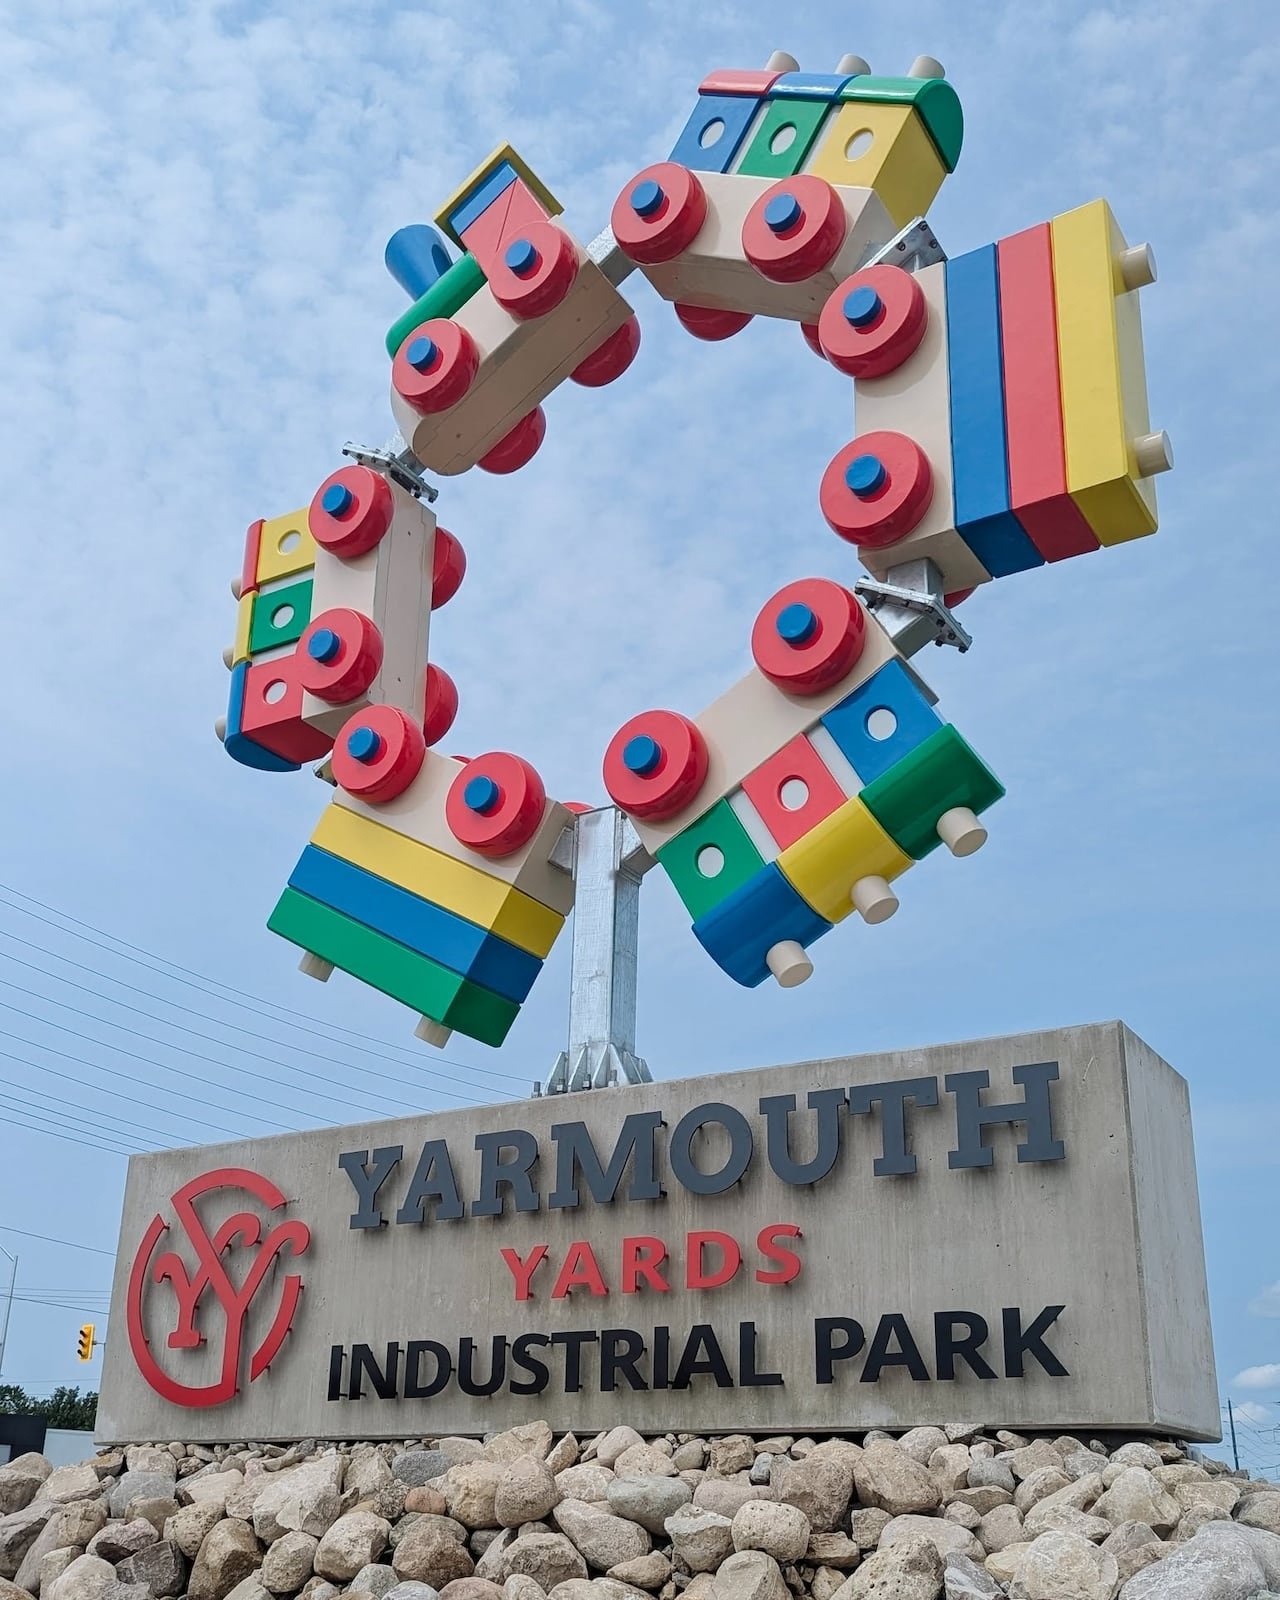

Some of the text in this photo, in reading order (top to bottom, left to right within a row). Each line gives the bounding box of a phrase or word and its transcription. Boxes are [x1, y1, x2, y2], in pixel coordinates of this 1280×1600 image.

[339, 1061, 1066, 1229] YARMOUTH
[501, 1223, 803, 1301] YARDS
[327, 1305, 1070, 1402] INDUSTRIAL PARK
